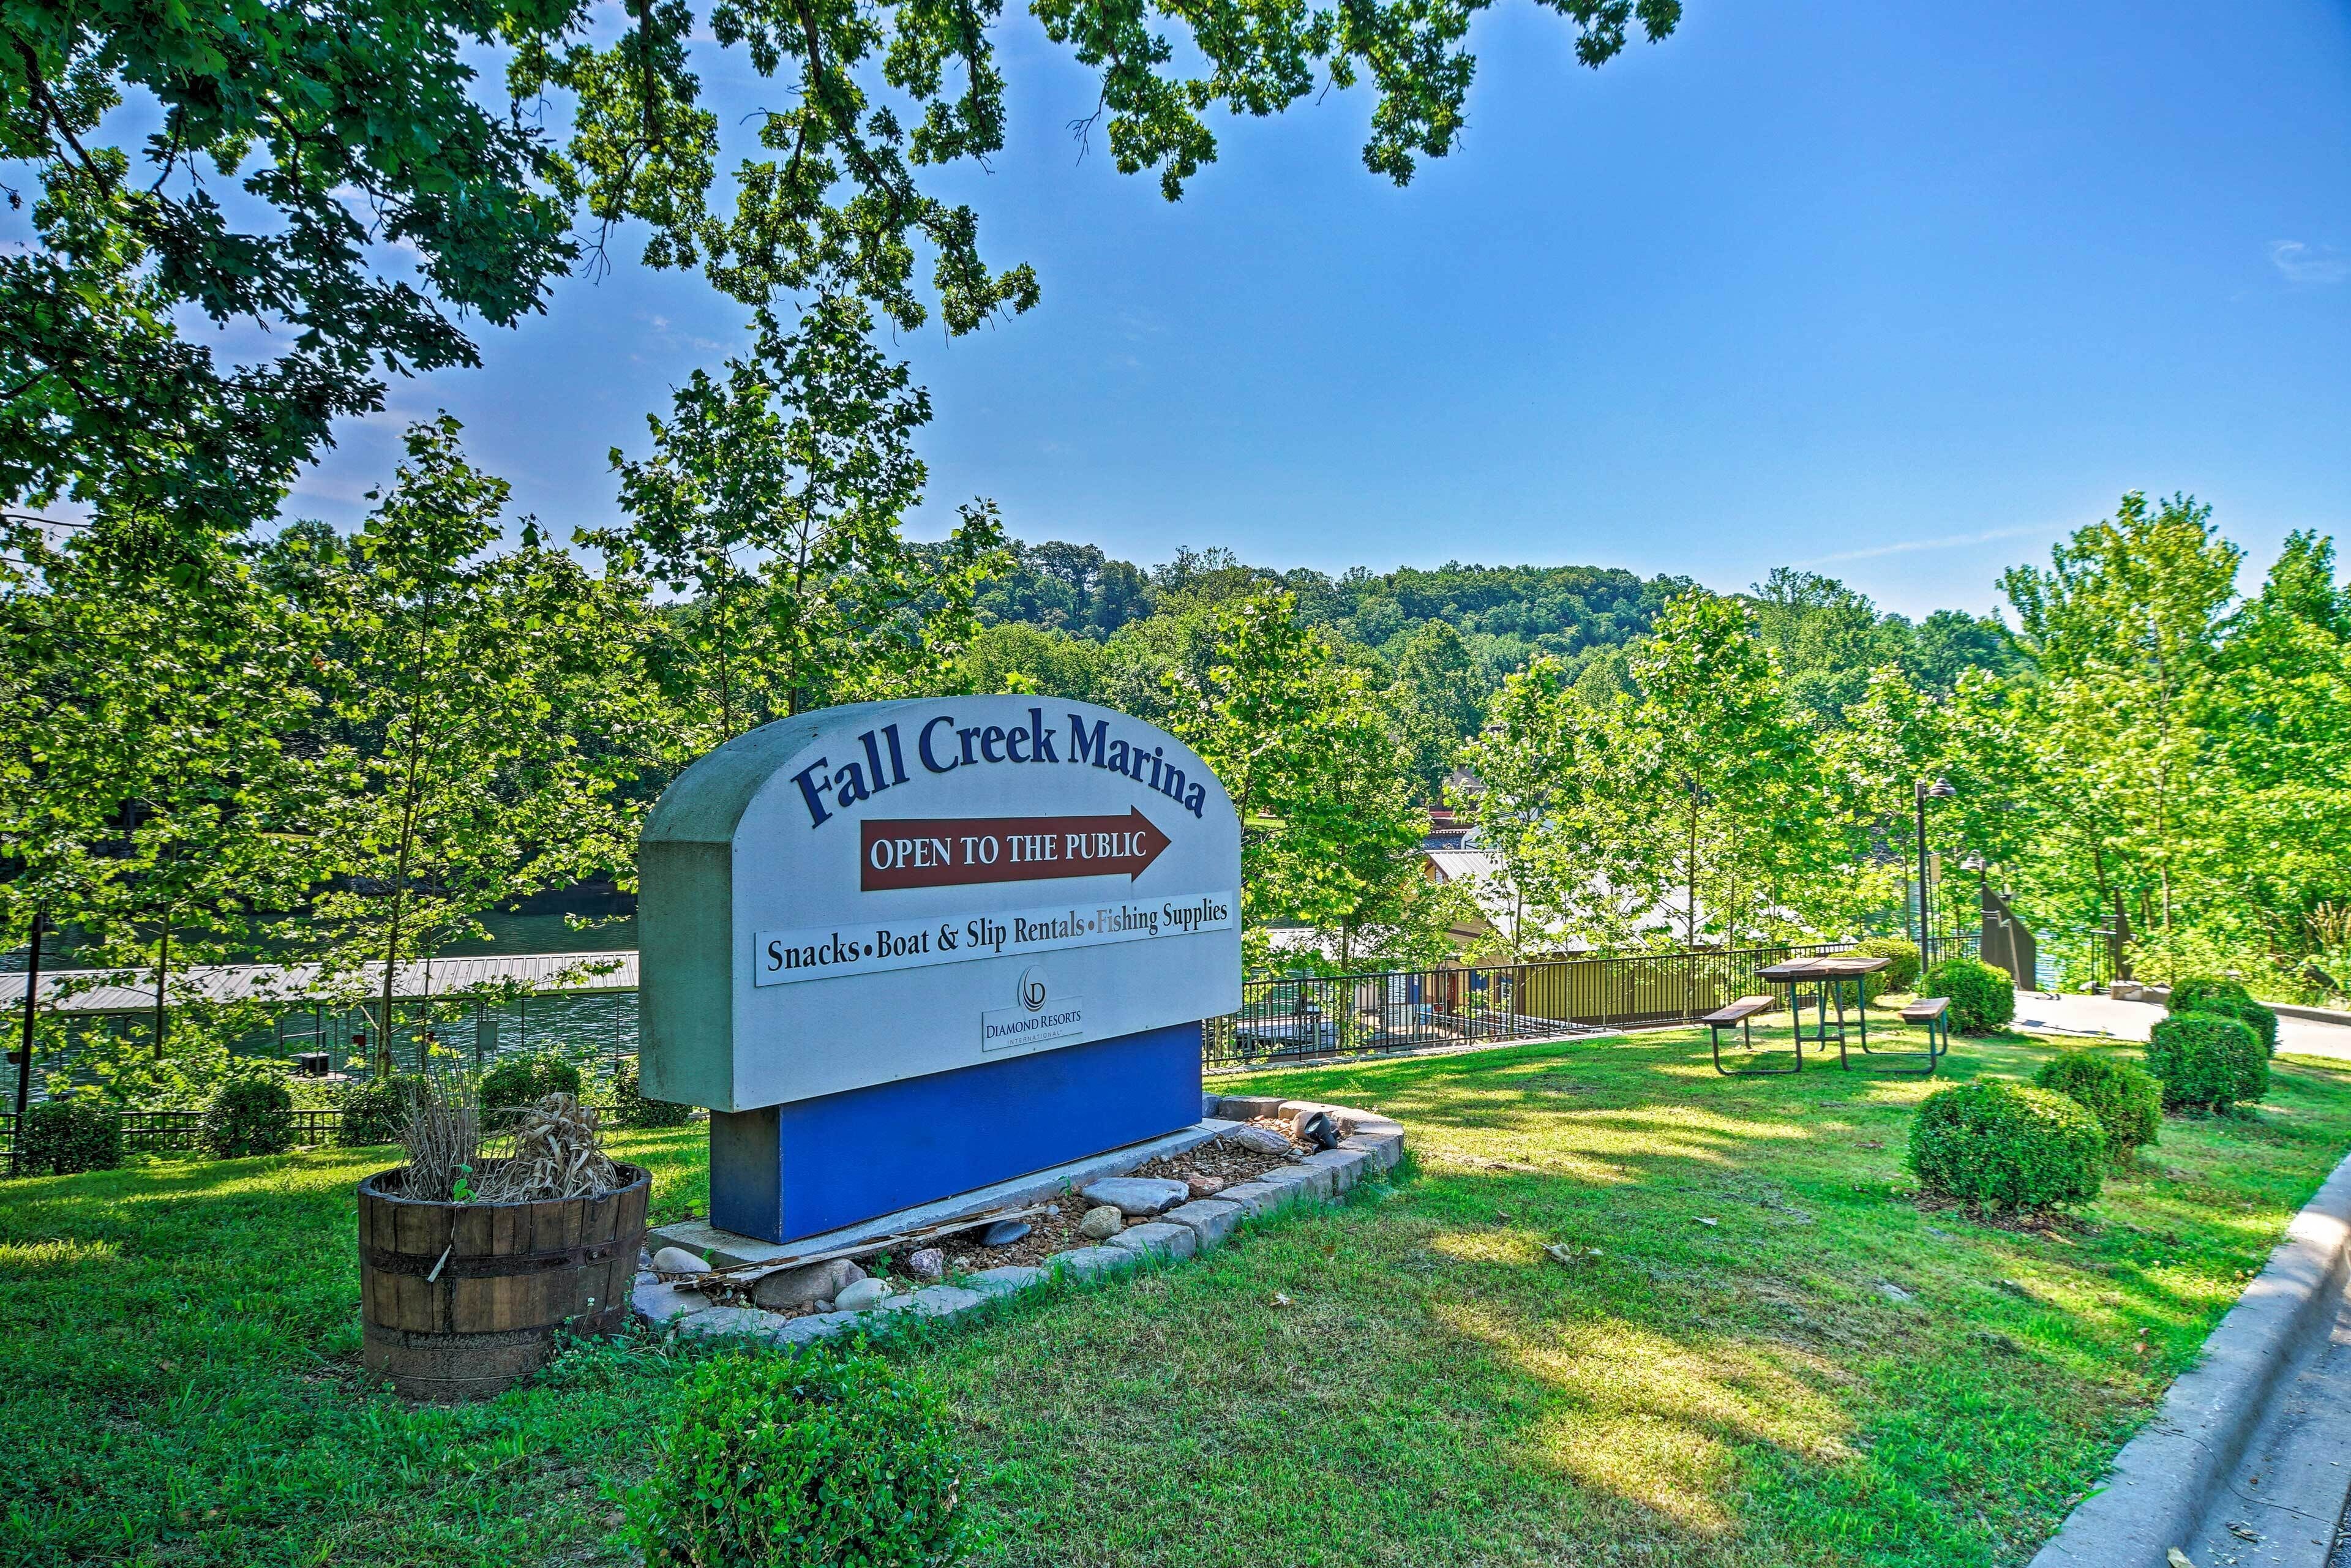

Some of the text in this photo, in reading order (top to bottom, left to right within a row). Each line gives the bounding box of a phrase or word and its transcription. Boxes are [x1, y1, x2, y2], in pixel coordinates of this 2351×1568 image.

[790, 708, 1206, 829] Fall Creek Marina
[871, 831, 1147, 869] OPEN TO THE PUBLIC
[767, 898, 1228, 972] Snacks Boat & Slip Rentals Fishing Supplies
[986, 1010, 1081, 1038] DIAMOND RESORTS
